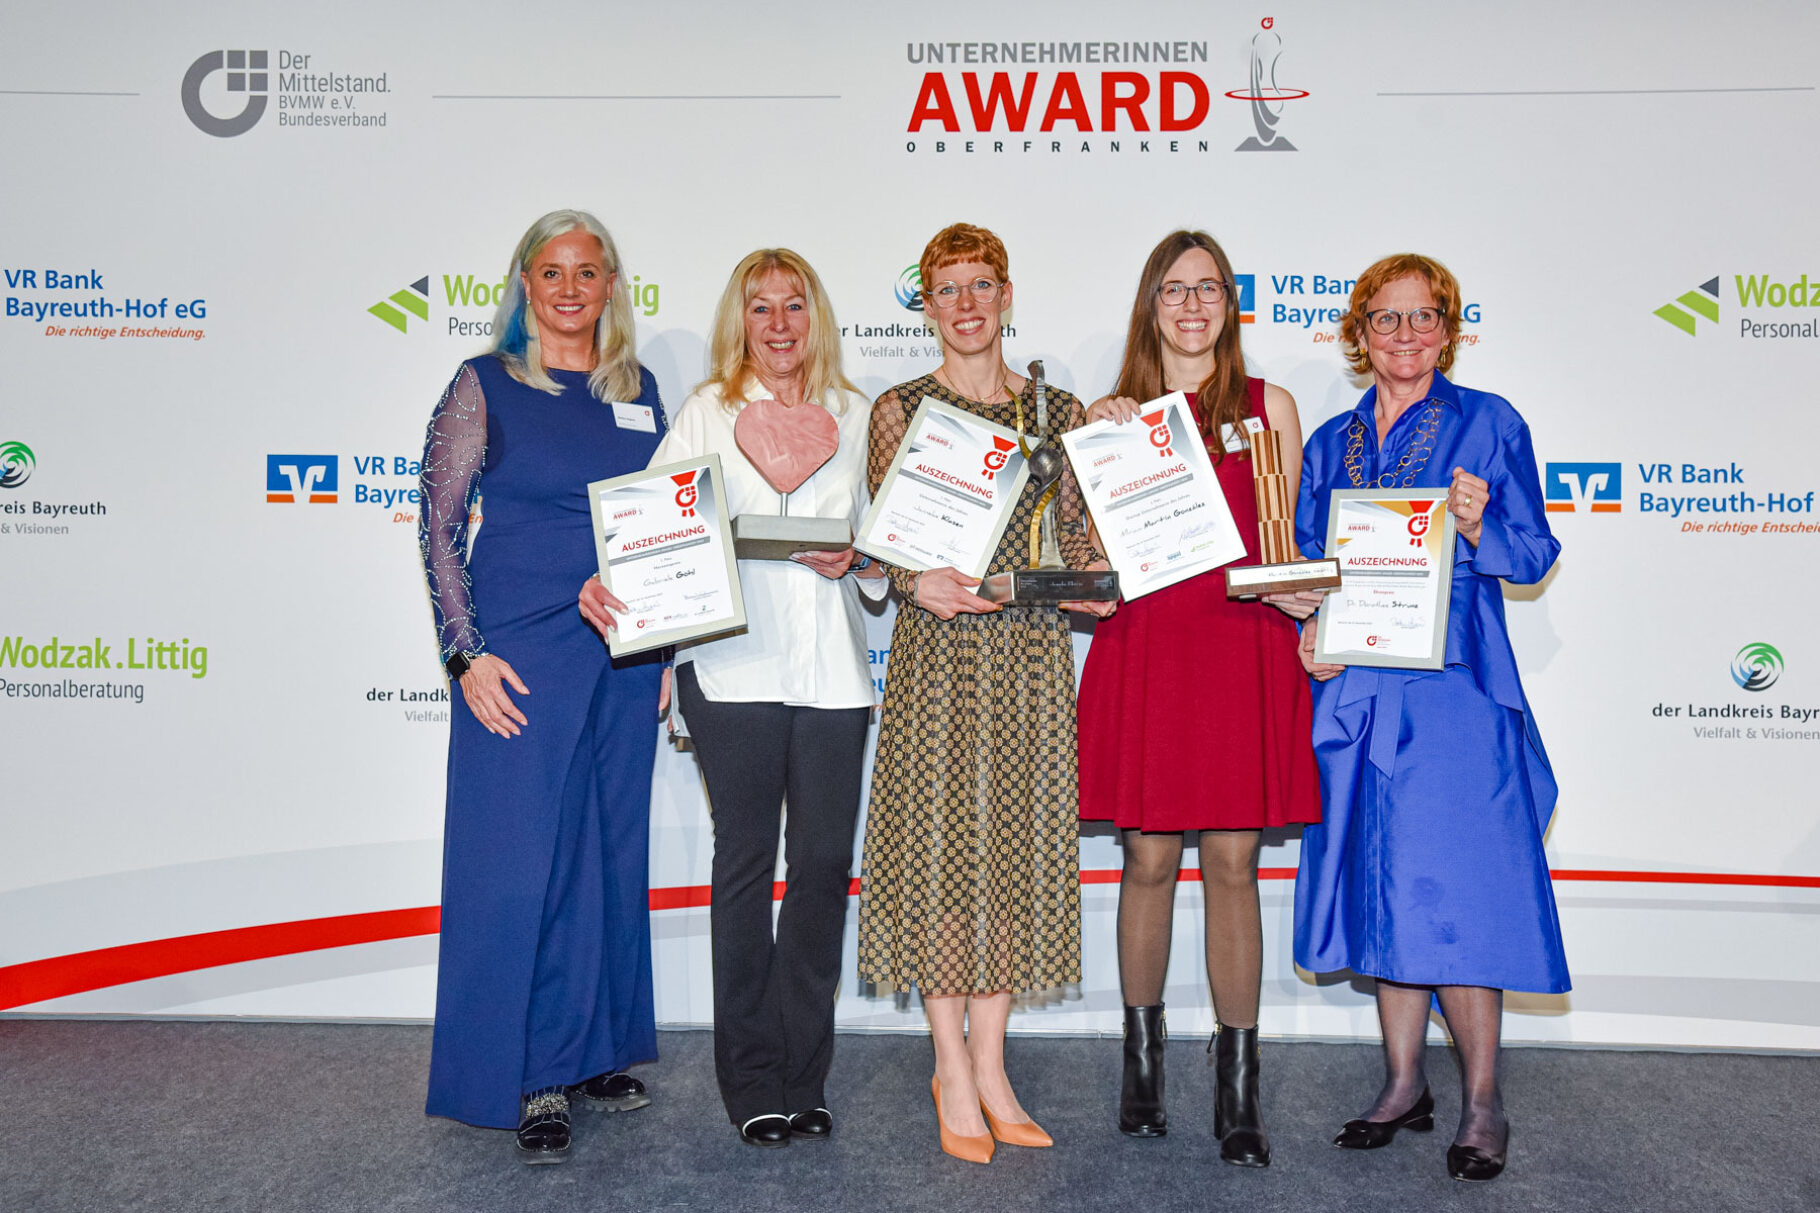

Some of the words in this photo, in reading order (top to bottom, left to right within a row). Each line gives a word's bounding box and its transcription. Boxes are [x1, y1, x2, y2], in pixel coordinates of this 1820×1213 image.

[279, 50, 311, 70] Der
[906, 41, 1208, 64] UNTERNEHMERINNEN
[279, 72, 391, 93] Mittelstand.
[279, 95, 325, 110] BVMW
[906, 71, 1210, 132] AWARD
[279, 112, 387, 127] Bundesverband
[906, 140, 1209, 153] OBERFRANKEN
[4, 269, 37, 289] VR
[45, 269, 104, 290] Bank
[1271, 275, 1305, 295] VR
[6, 296, 168, 322] Bayreuth-Hof
[175, 299, 206, 319] eG
[1273, 303, 1348, 328] Bayre
[1460, 303, 1481, 323] G
[45, 325, 67, 337] Die
[69, 326, 116, 340] richtige
[119, 327, 206, 341] Entscheidung.
[855, 323, 935, 338] Landkreis
[1741, 318, 1819, 338] Personal
[1313, 331, 1335, 344] Die
[859, 346, 905, 358] Vielfalt
[910, 346, 920, 358] &
[926, 434, 949, 447] AWARD
[353, 456, 386, 476] VR
[1093, 455, 1116, 468] AWARD
[1109, 463, 1187, 499] AUSZEICHNUNG
[1638, 463, 1673, 484] VR
[1681, 462, 1744, 484] Bank
[915, 463, 994, 500] AUSZEICHNUNG
[32, 501, 107, 519] Bayreuth
[1640, 491, 1815, 518] Bayreuth-Hof
[393, 512, 415, 524] Die
[613, 509, 637, 520] AWARD
[15, 522, 69, 535] Visionen
[1681, 521, 1704, 533] Die
[1707, 521, 1758, 536] richtige
[621, 525, 706, 552] AUSZEICHNUNG
[1347, 557, 1428, 567] AUSZEICHNUNG
[366, 687, 394, 702] der
[404, 710, 449, 723] Vielfalt
[1652, 703, 1682, 718] der
[1688, 703, 1774, 719] Landkreis
[1694, 726, 1741, 740] Vielfalt
[1746, 727, 1757, 740] &
[1762, 727, 1820, 741] Visionen
